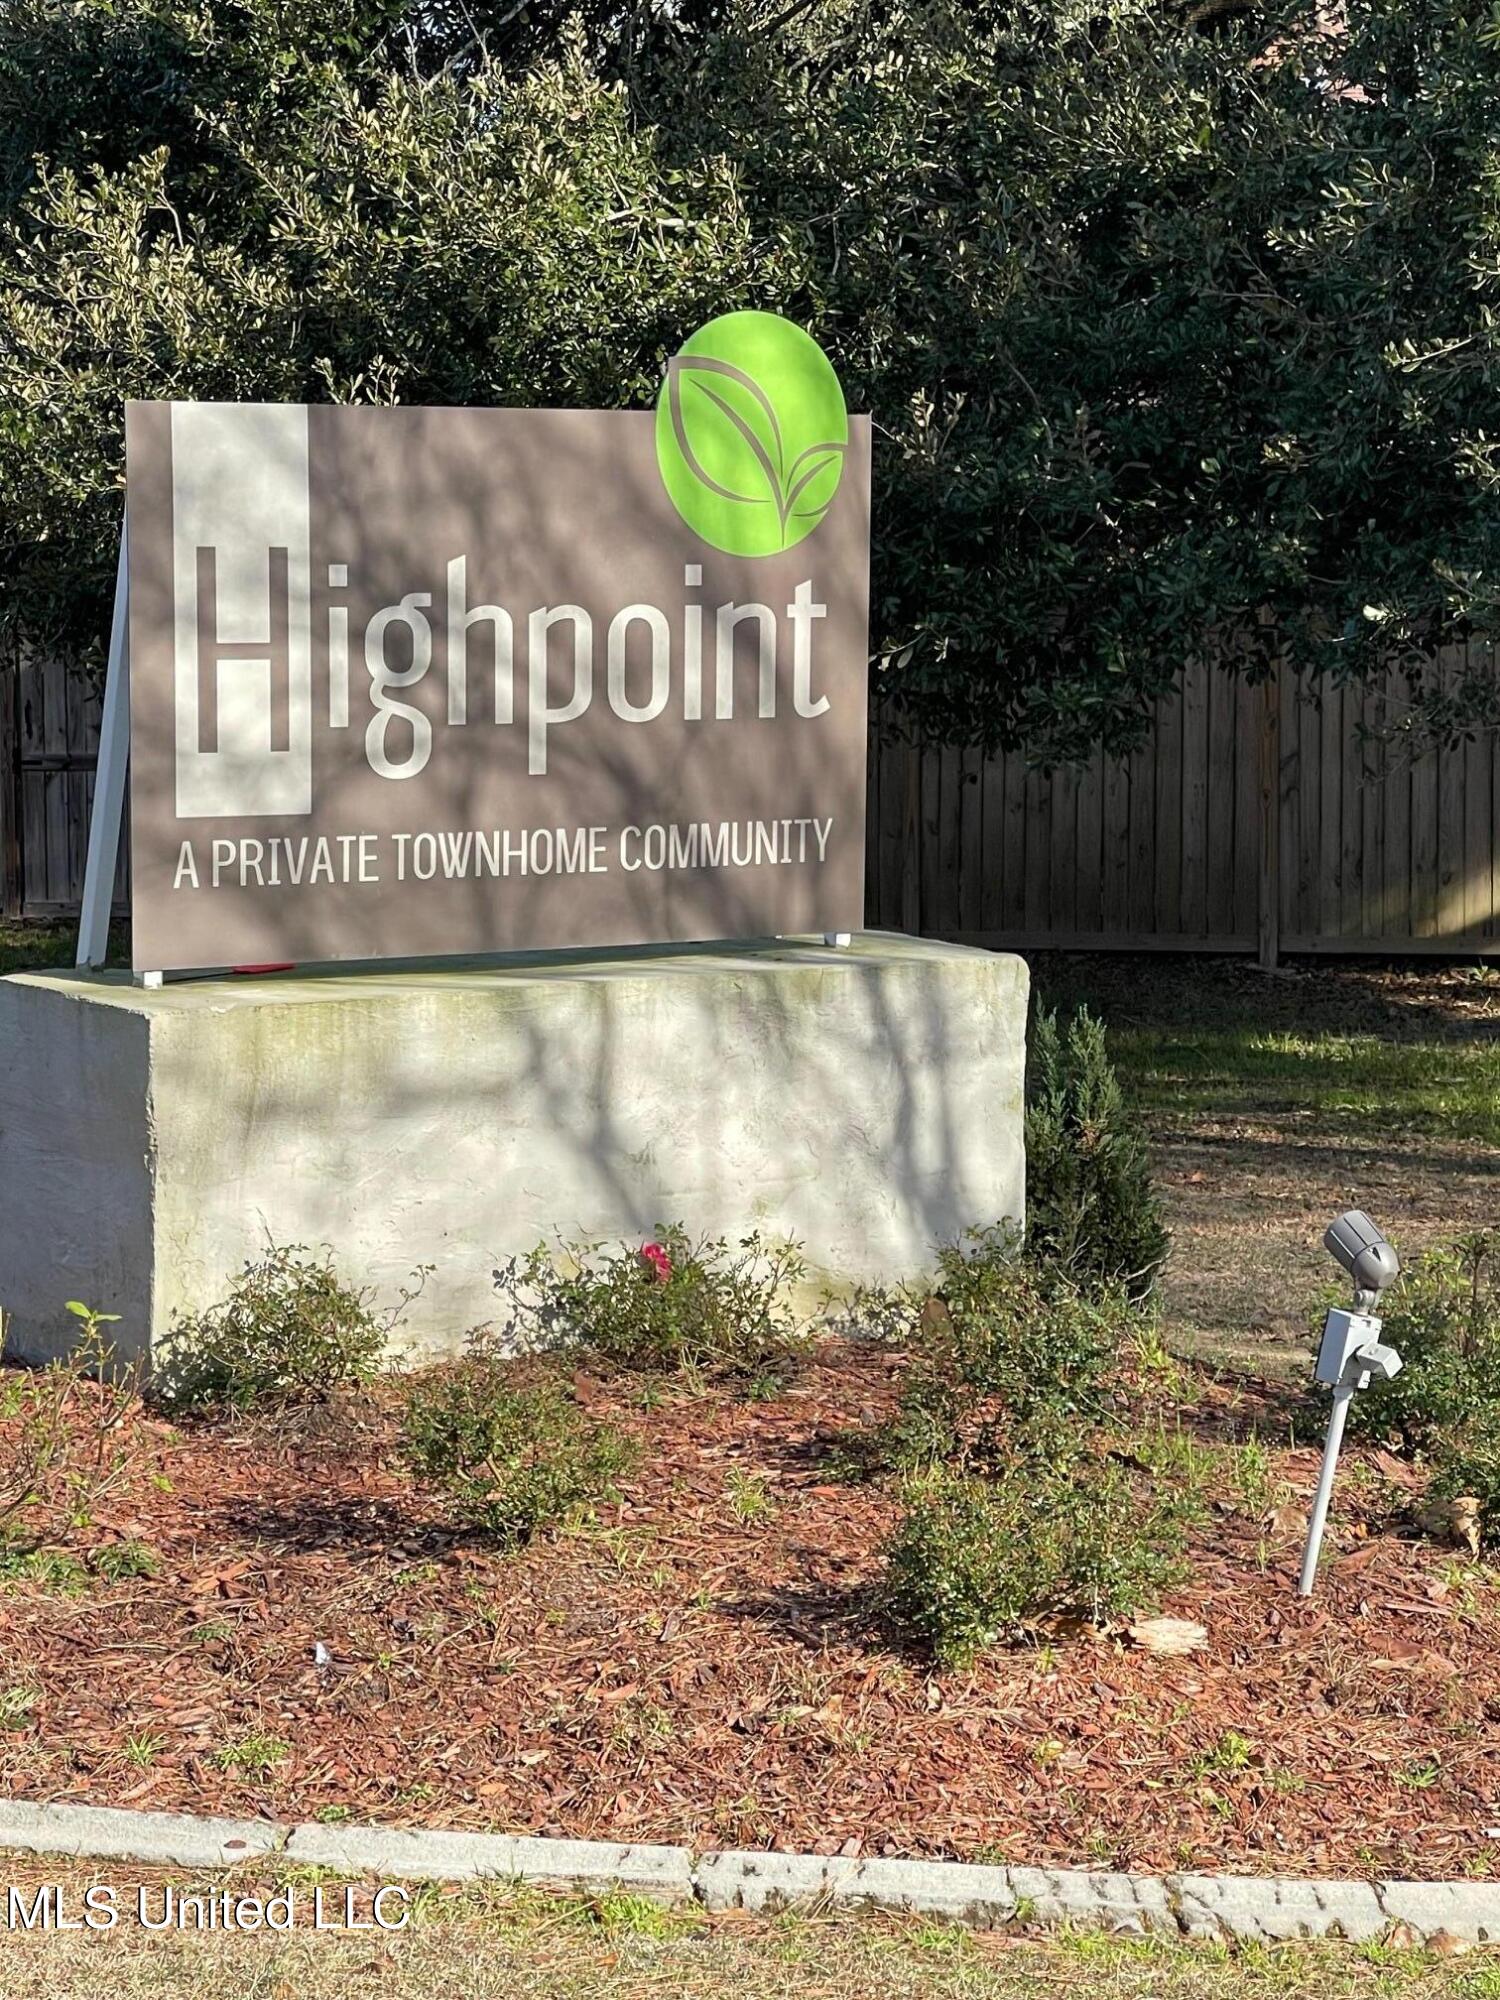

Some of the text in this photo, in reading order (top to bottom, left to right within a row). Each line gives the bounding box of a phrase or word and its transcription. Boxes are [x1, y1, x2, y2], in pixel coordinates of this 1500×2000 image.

[196, 546, 831, 779] Highpoint
[173, 818, 834, 889] A PRIVATE TOWNHOME COMMUNITY
